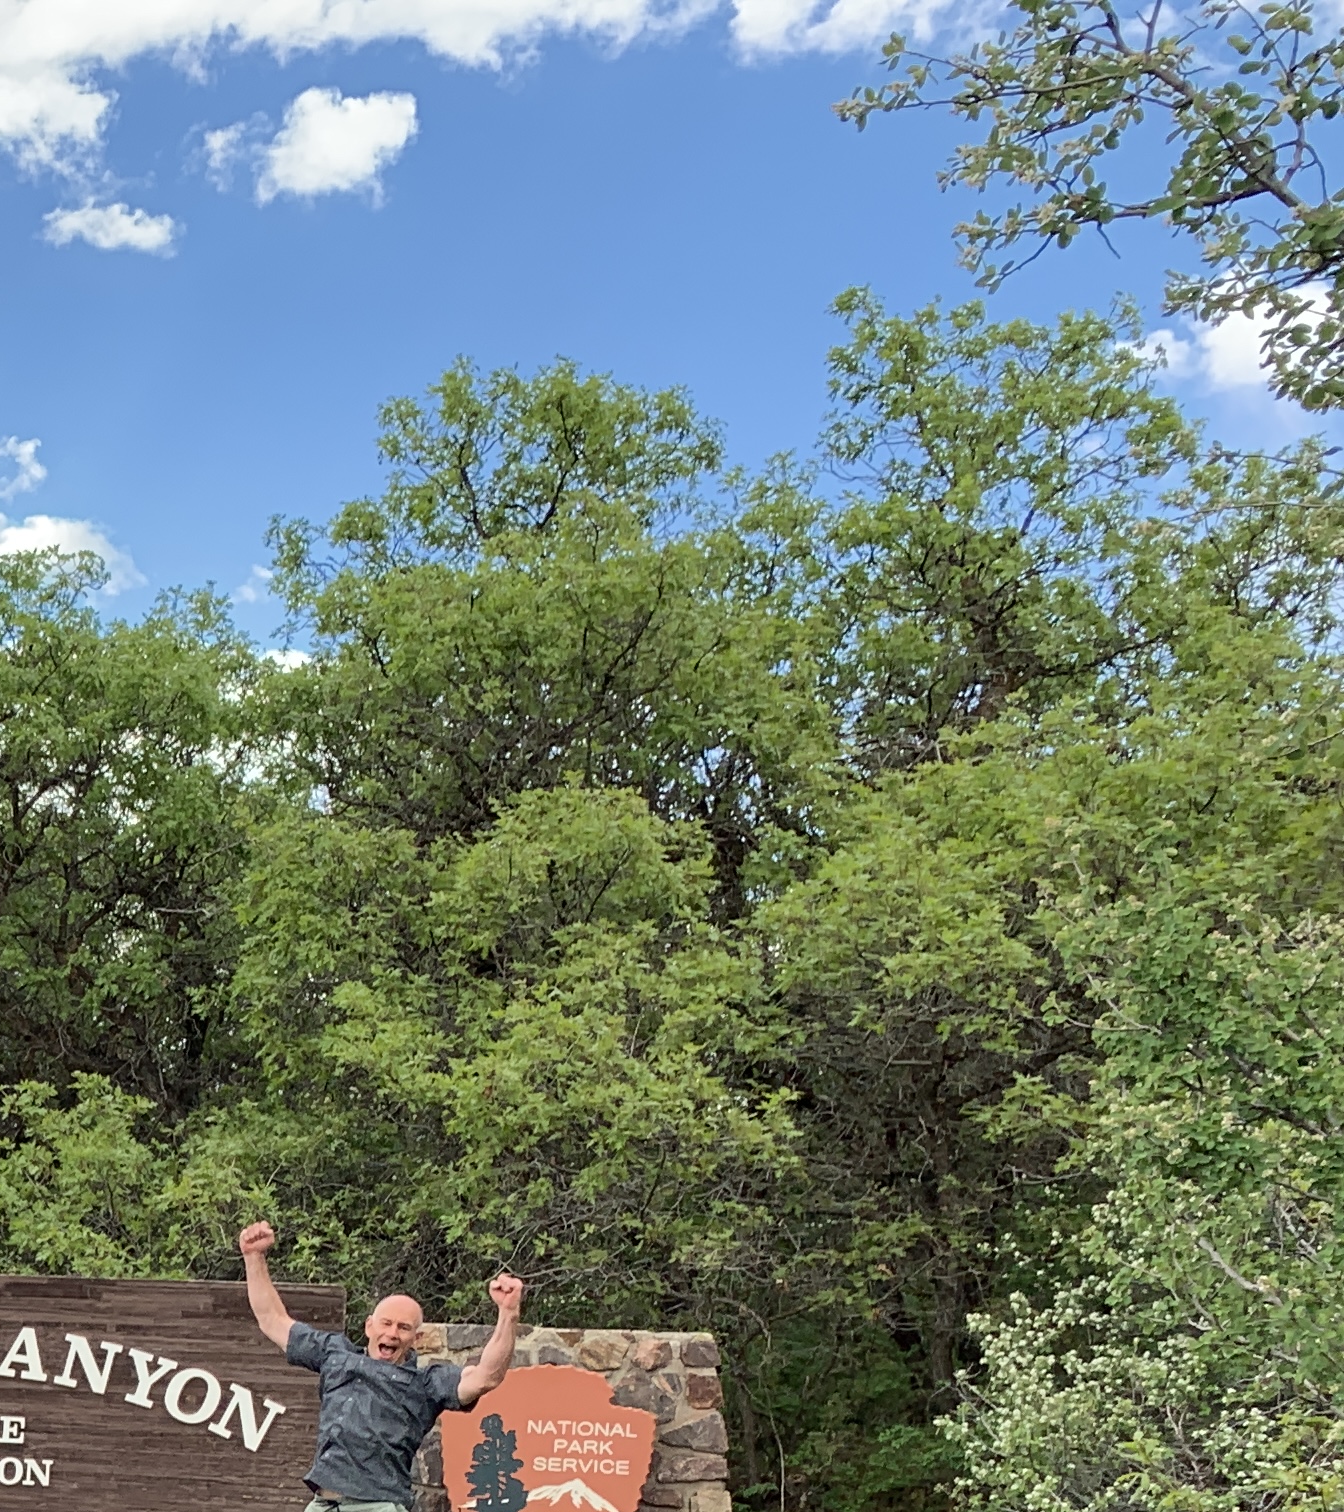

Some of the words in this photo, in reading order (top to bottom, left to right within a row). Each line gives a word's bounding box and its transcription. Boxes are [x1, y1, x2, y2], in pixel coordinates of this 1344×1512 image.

[527, 1420, 638, 1438] NATIONAL
[553, 1439, 614, 1455] PARK
[532, 1456, 630, 1475] SERVICE
